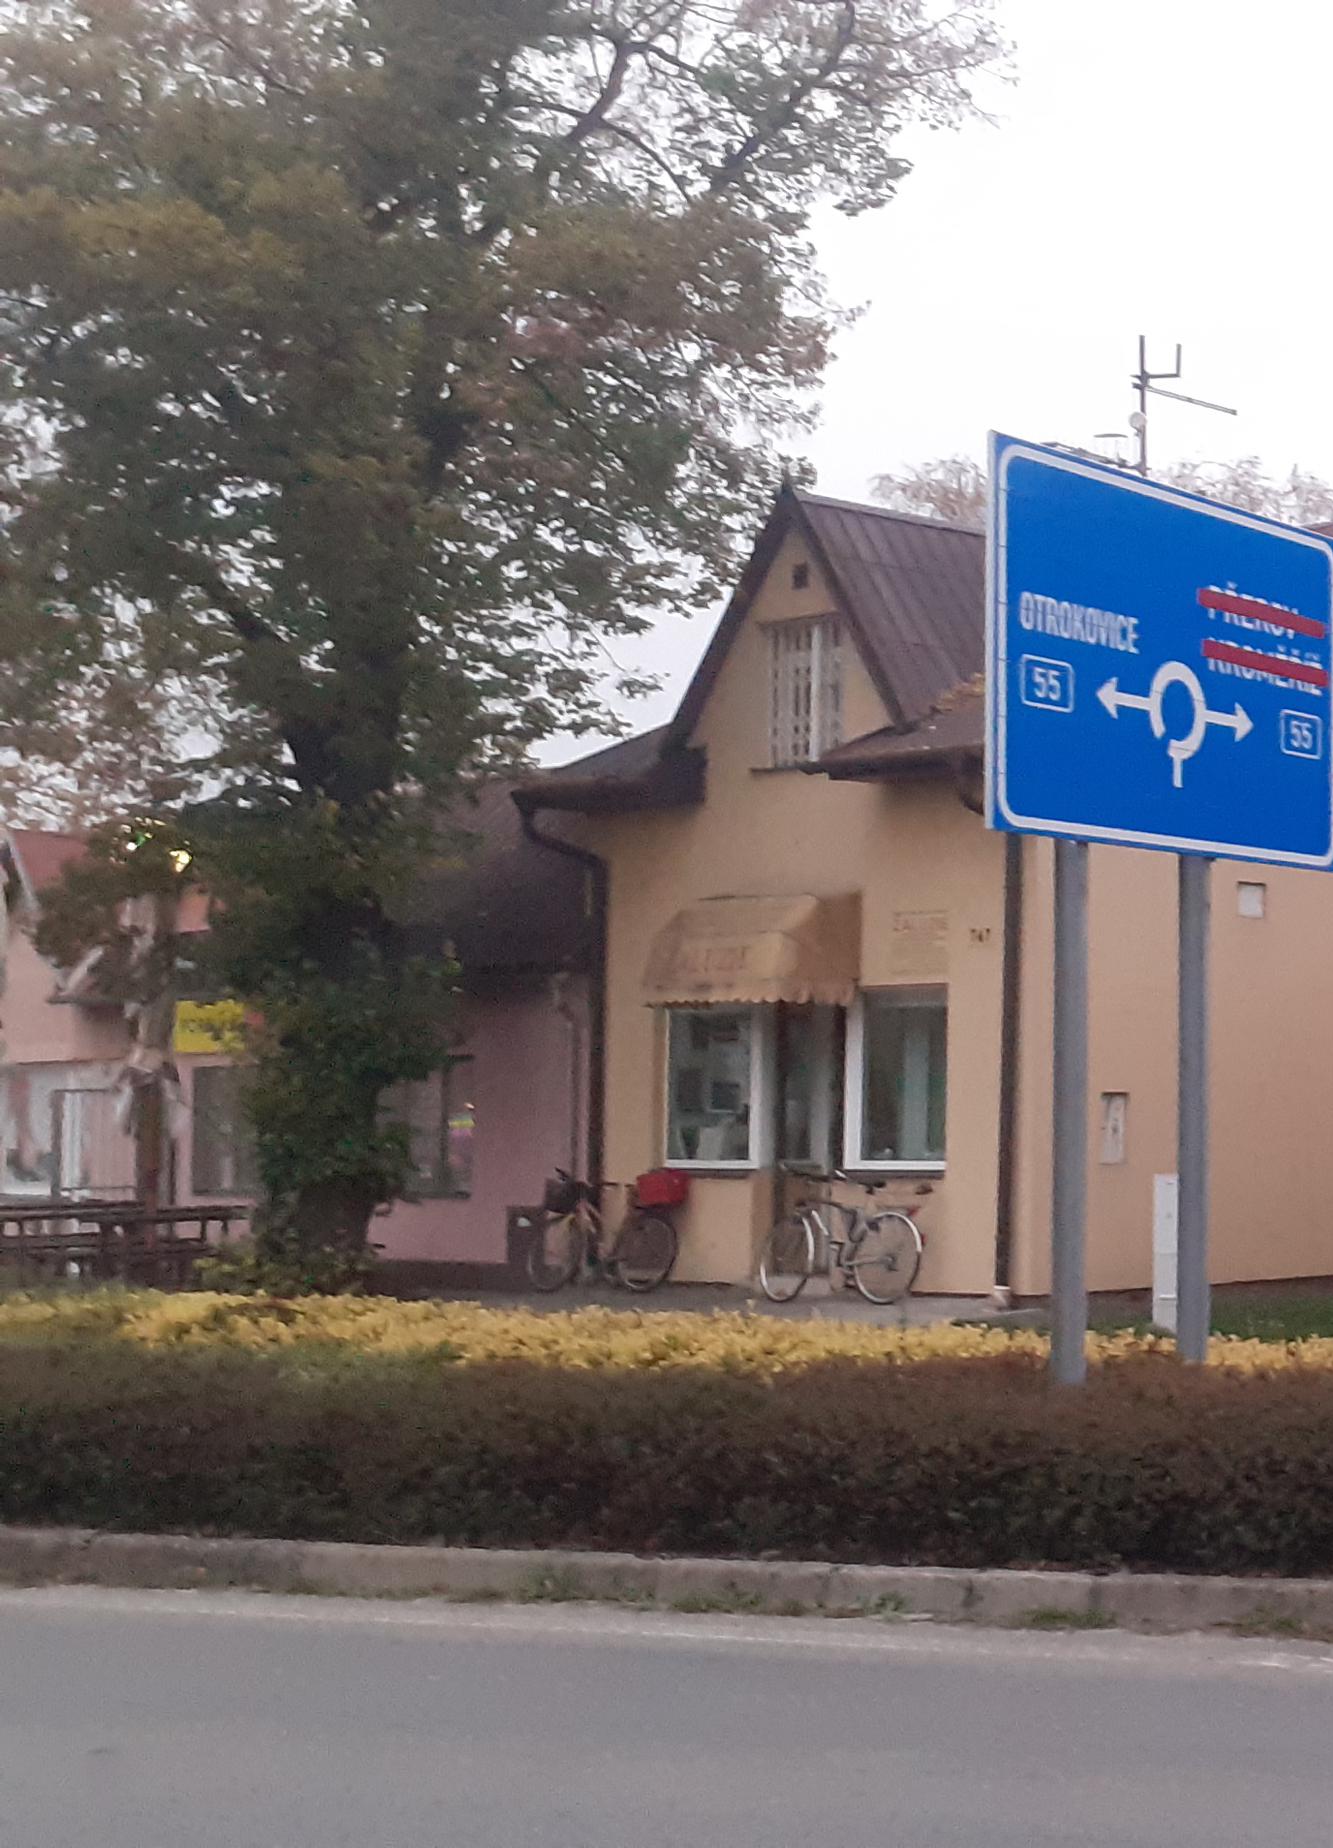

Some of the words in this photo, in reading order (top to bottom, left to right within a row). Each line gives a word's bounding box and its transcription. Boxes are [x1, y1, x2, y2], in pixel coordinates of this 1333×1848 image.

[1019, 591, 1140, 655] OTROKOVICE
[1033, 666, 1061, 701] 55
[1289, 719, 1313, 750] 55
